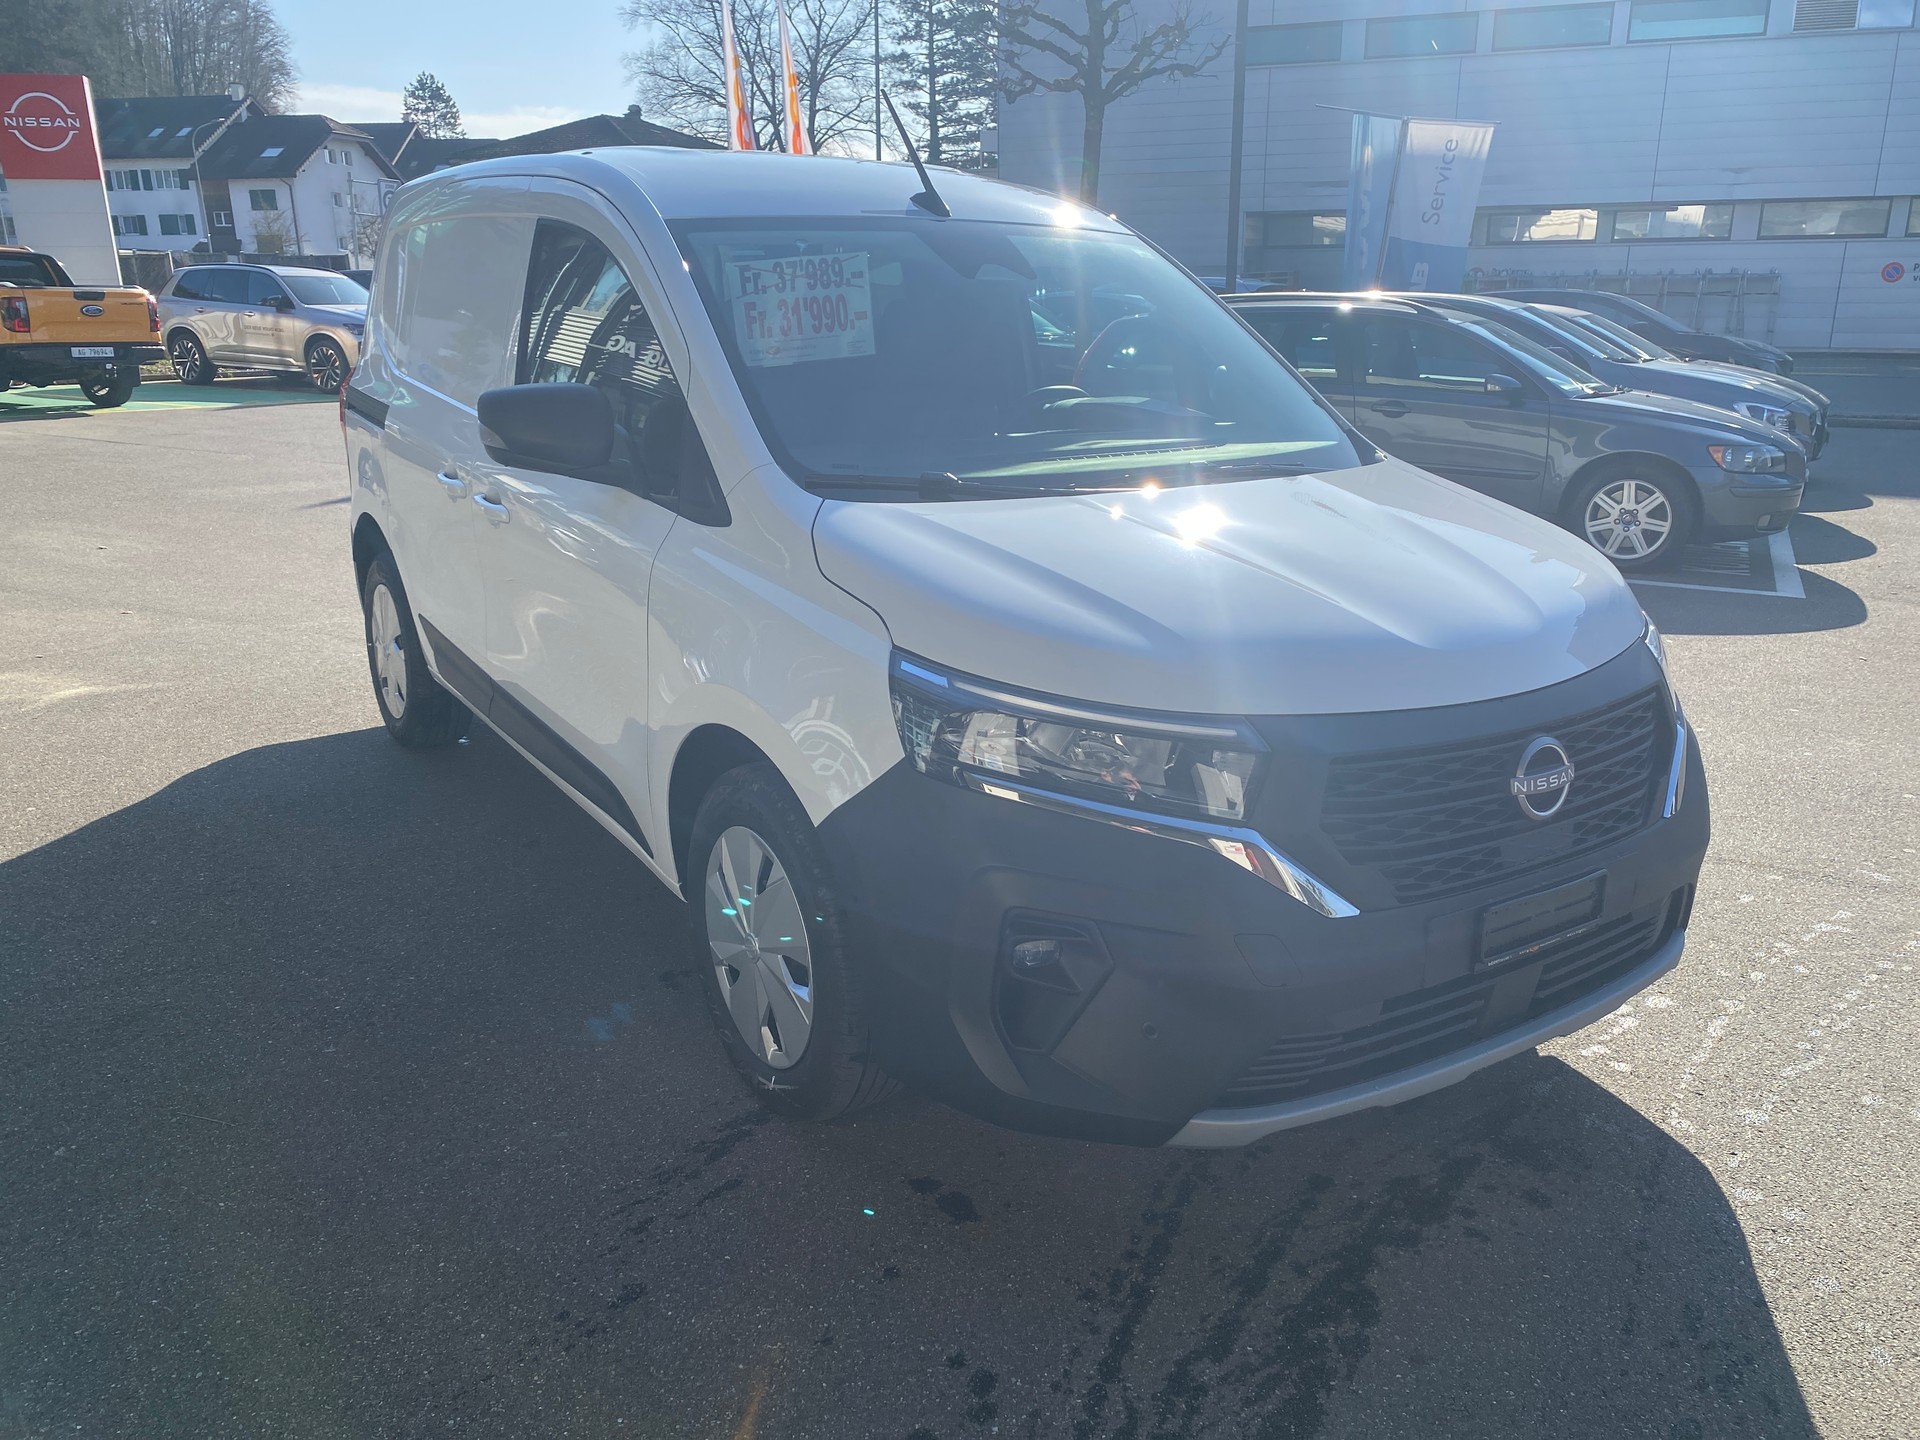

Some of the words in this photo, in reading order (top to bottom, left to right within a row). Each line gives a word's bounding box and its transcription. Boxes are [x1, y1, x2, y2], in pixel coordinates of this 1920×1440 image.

[3, 116, 81, 128] NISSAN
[1421, 138, 1459, 225] Service
[738, 264, 767, 296] Fr.
[743, 301, 773, 339] Fr.
[1513, 766, 1575, 793] NISSAN
